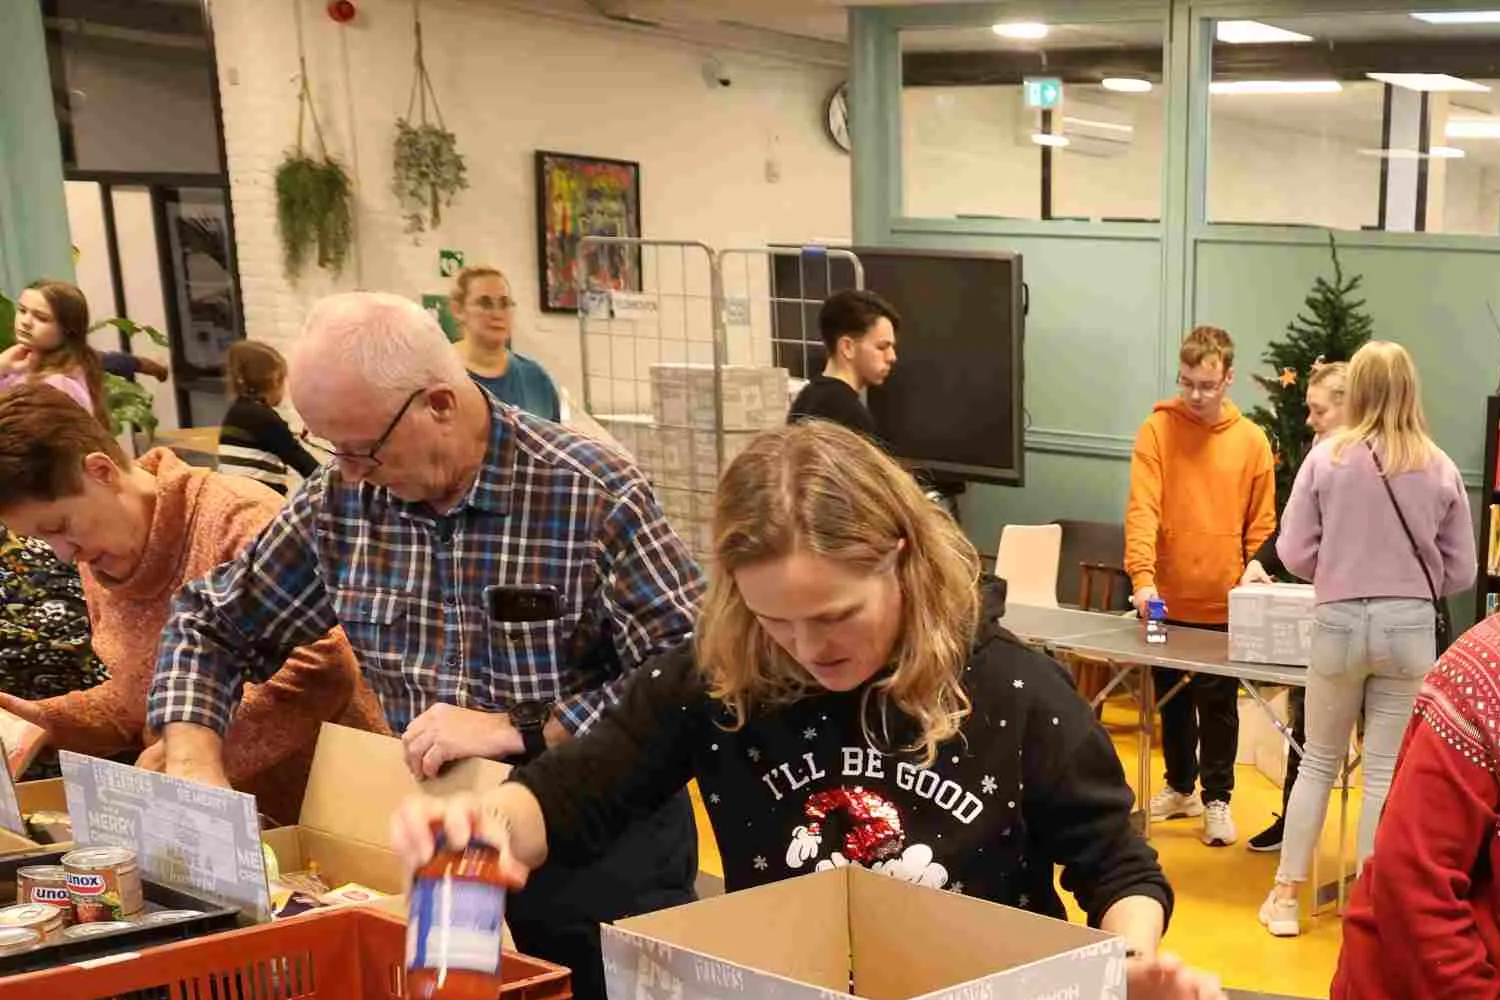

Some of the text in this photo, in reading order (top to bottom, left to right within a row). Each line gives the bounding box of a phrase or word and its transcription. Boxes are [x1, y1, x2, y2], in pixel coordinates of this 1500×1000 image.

[762, 747, 984, 824] I'LL BE GOOD
[36, 888, 67, 900] uno
